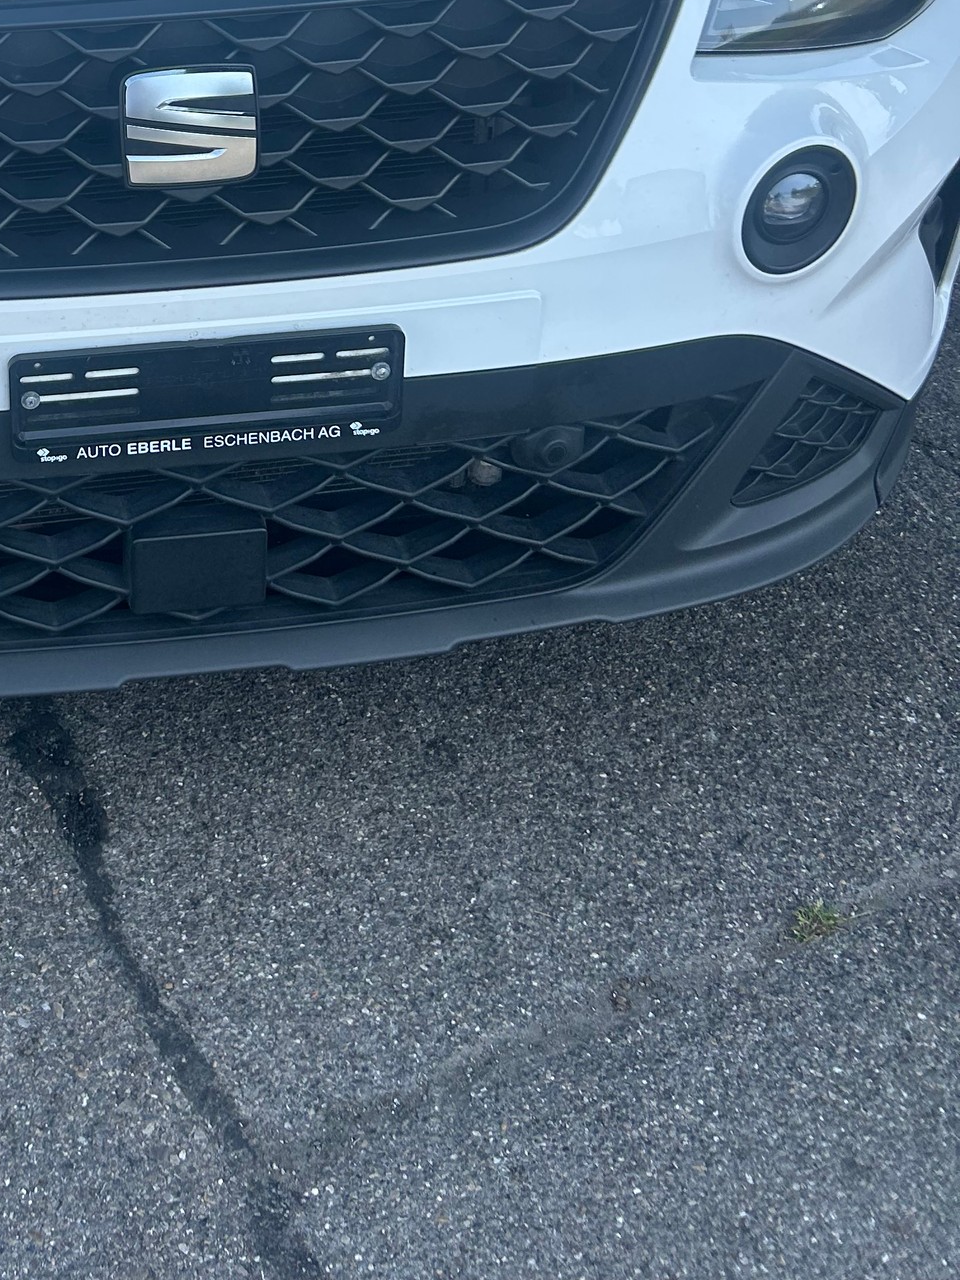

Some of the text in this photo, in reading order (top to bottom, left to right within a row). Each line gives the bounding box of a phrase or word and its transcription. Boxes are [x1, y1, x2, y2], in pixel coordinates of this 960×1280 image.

[76, 425, 341, 460] AUTO EBERLE ESCHENBACH AG
